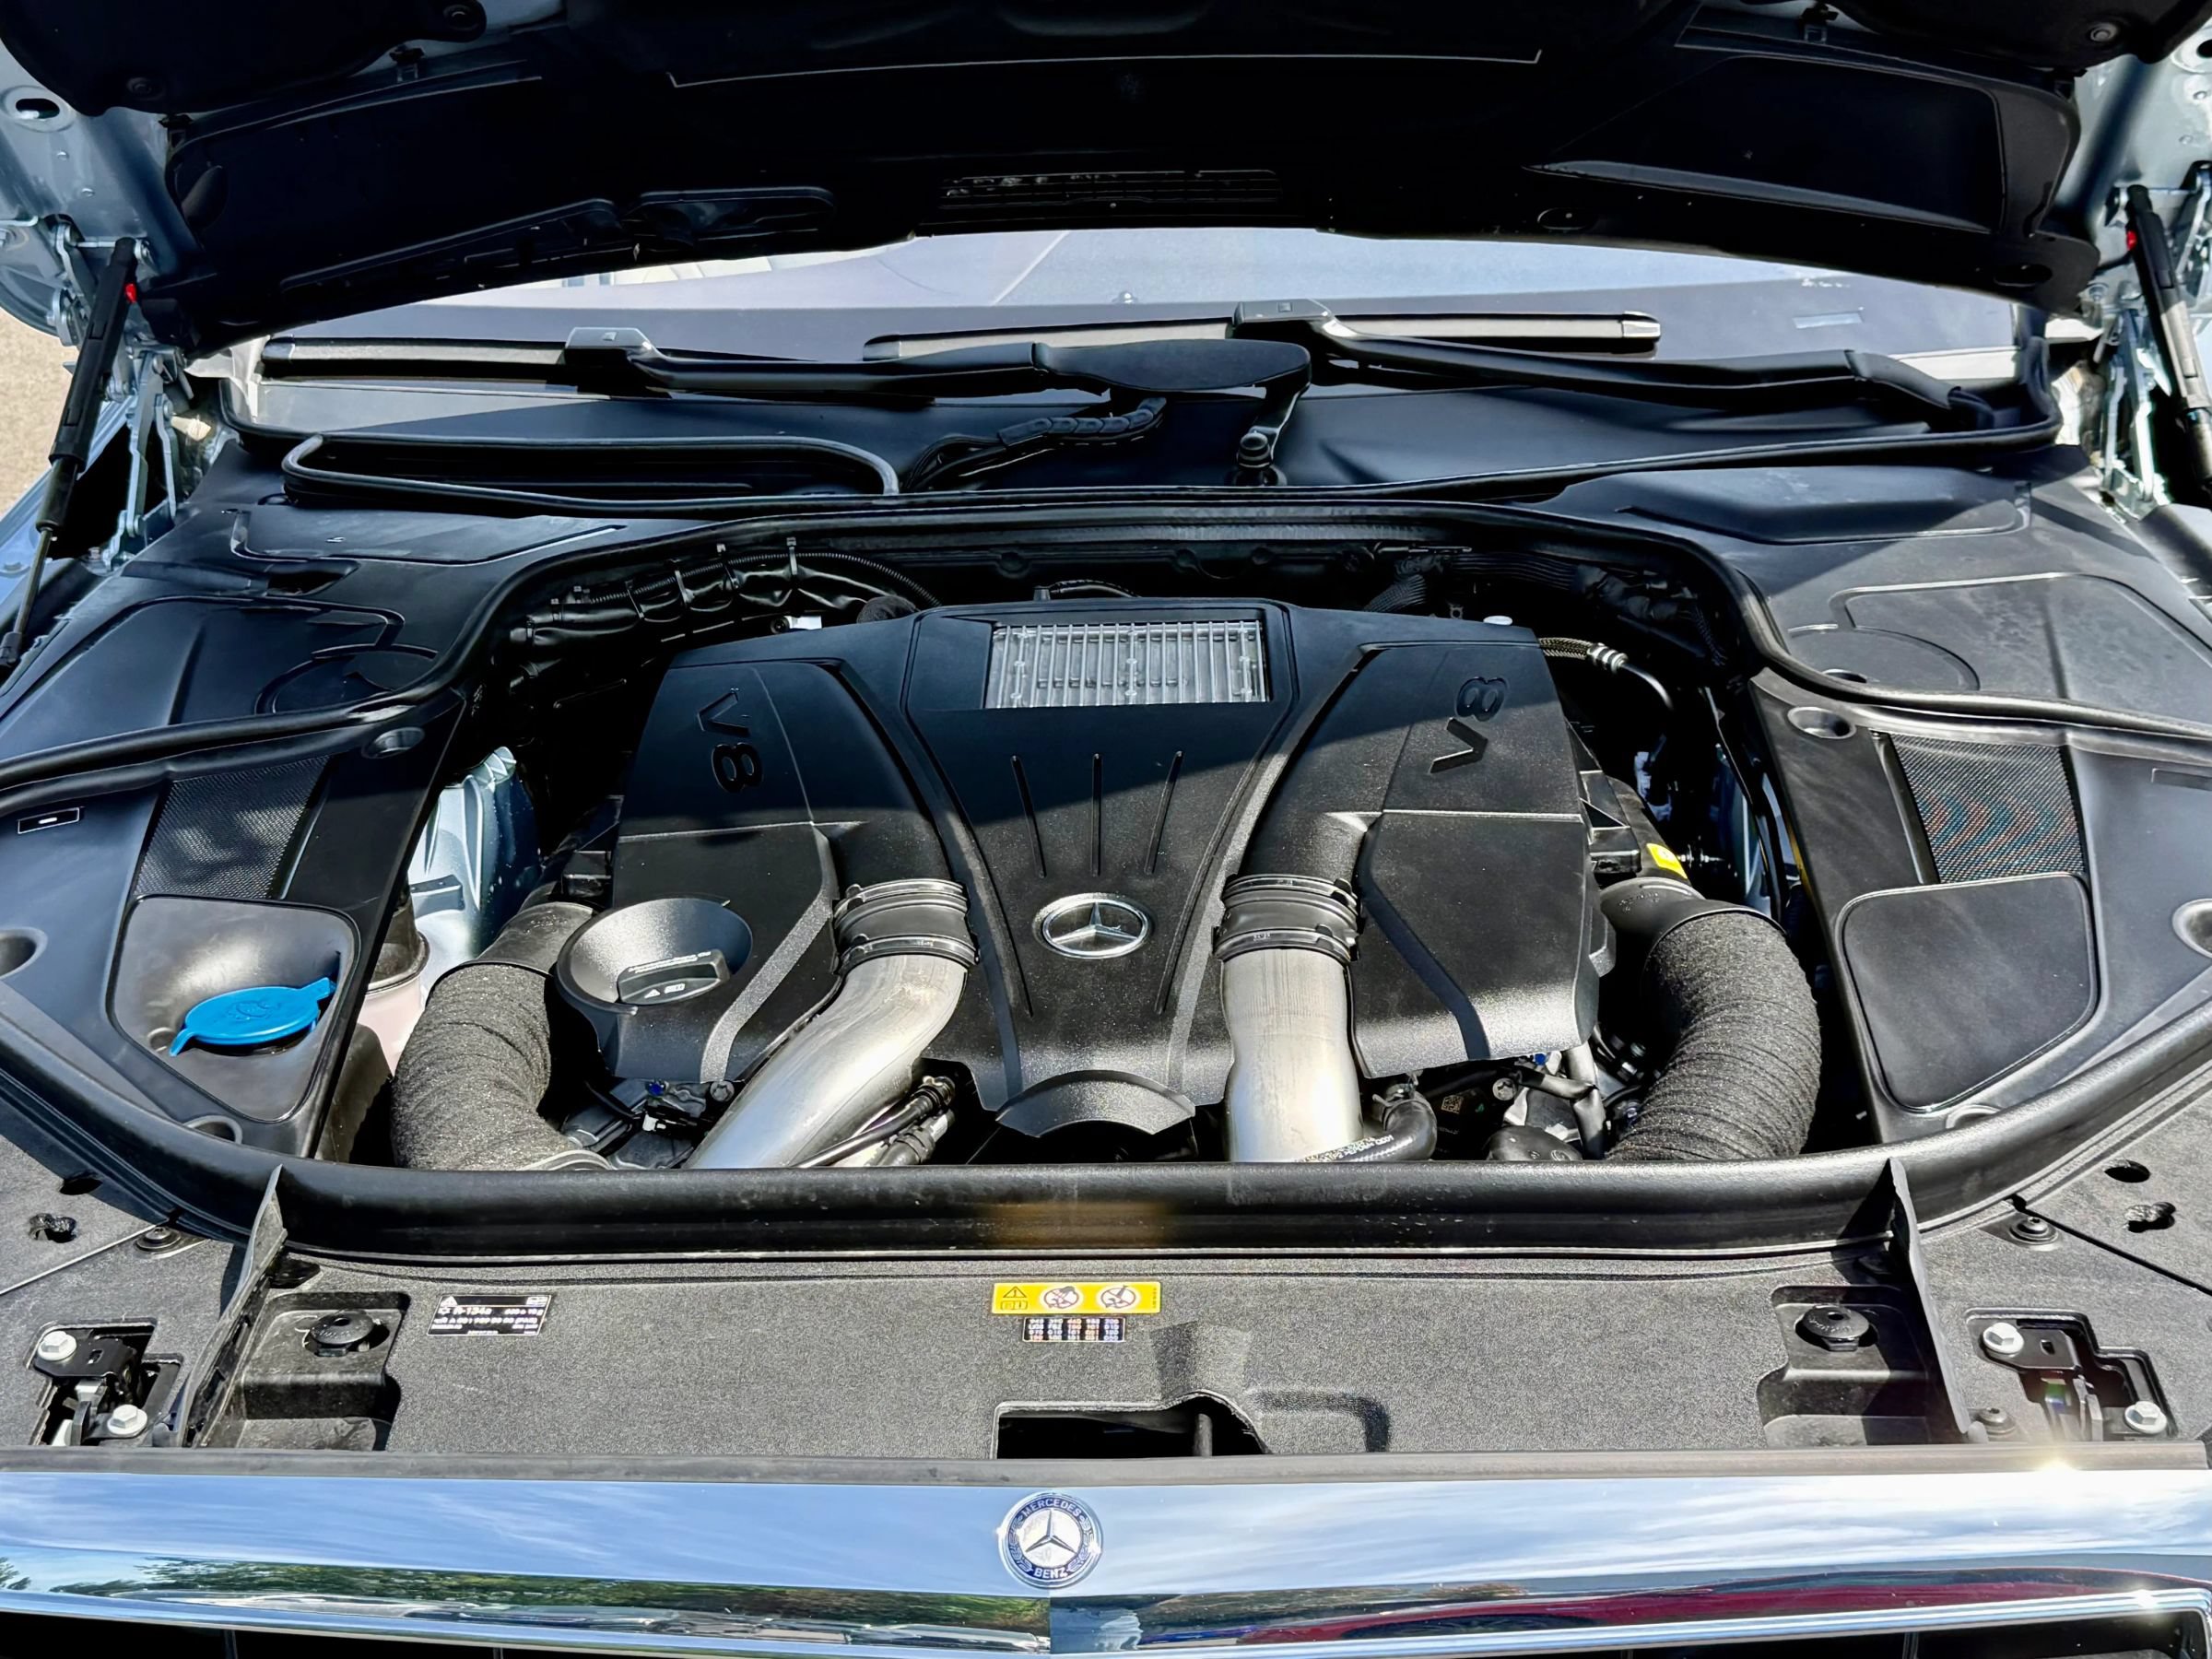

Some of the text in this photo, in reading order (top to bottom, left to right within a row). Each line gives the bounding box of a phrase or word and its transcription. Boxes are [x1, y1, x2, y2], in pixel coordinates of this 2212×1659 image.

[695, 688, 764, 794] V8
[1427, 676, 1510, 775] V8
[1021, 1498, 1082, 1517] MERCEDES
[1033, 1567, 1069, 1580] BENZ
